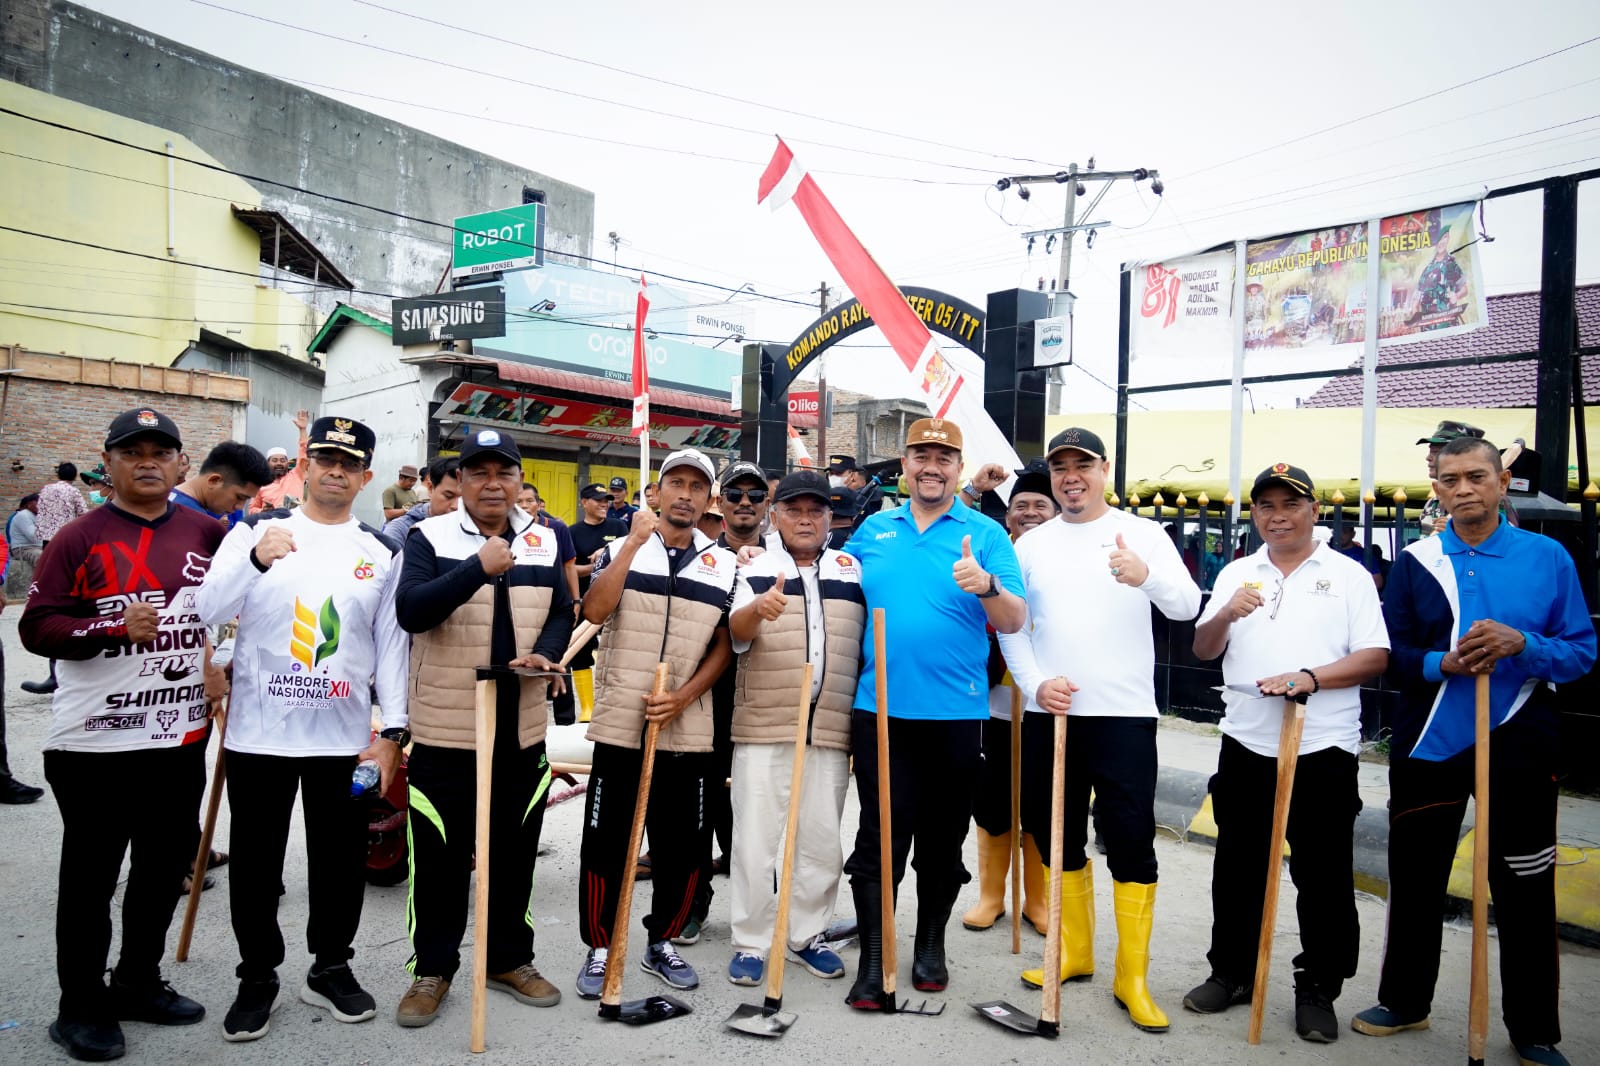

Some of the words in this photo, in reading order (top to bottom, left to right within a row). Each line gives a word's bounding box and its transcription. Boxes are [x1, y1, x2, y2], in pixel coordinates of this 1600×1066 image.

[463, 223, 525, 250] ROBOT
[1298, 246, 1355, 268] REPUBLIK
[1357, 231, 1431, 262] INONESIA
[471, 265, 490, 273] ERWIN
[491, 261, 514, 271] PONSEL
[1181, 270, 1217, 282] INDONESIA
[1187, 294, 1203, 303] ADIL
[401, 300, 485, 331] SAMSUNG
[1185, 306, 1219, 317] MAKMUR
[696, 315, 719, 330] ERWIN
[720, 320, 747, 335] PONSEL
[786, 315, 840, 371] KOMANDO
[934, 302, 954, 328] 05
[959, 312, 980, 341] TT
[604, 369, 625, 381] ERWIN
[139, 652, 199, 682] FOX
[268, 674, 330, 689] JAMBORE
[268, 685, 332, 700] NASIONAL
[328, 680, 350, 698] XII
[284, 700, 314, 708] JAKARTA
[89, 715, 143, 728] Muc-Off
